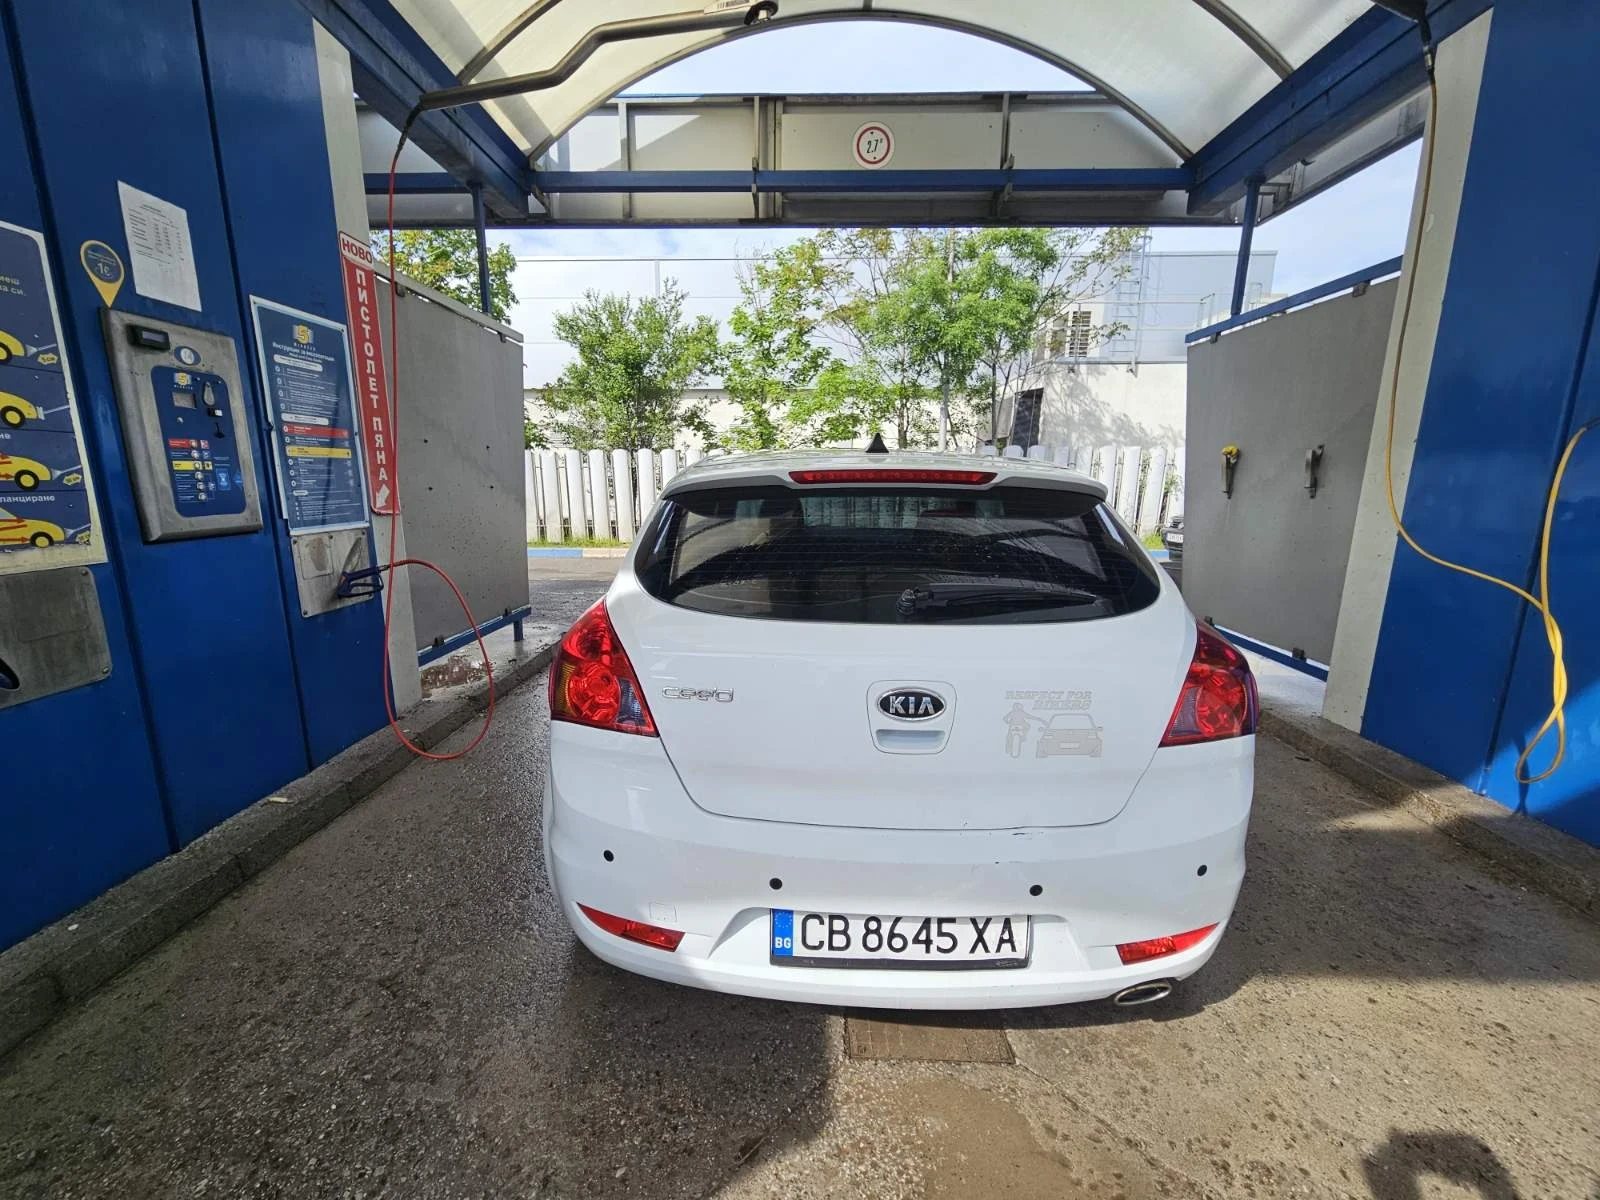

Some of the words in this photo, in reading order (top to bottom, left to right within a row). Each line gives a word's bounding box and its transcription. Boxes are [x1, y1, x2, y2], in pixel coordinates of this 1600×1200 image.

[341, 238, 373, 264] НОВО
[355, 268, 379, 409] ПИСТОЛЕТ
[372, 416, 388, 481] ПЯНА
[888, 695, 936, 715] KIA
[1005, 690, 1065, 700] RESPECT
[1066, 690, 1092, 701] FOR
[1031, 699, 1092, 711] BIKERS
[775, 936, 792, 949] BG
[801, 913, 851, 952] CB
[861, 915, 958, 954] 8645
[968, 916, 1018, 954] XA
